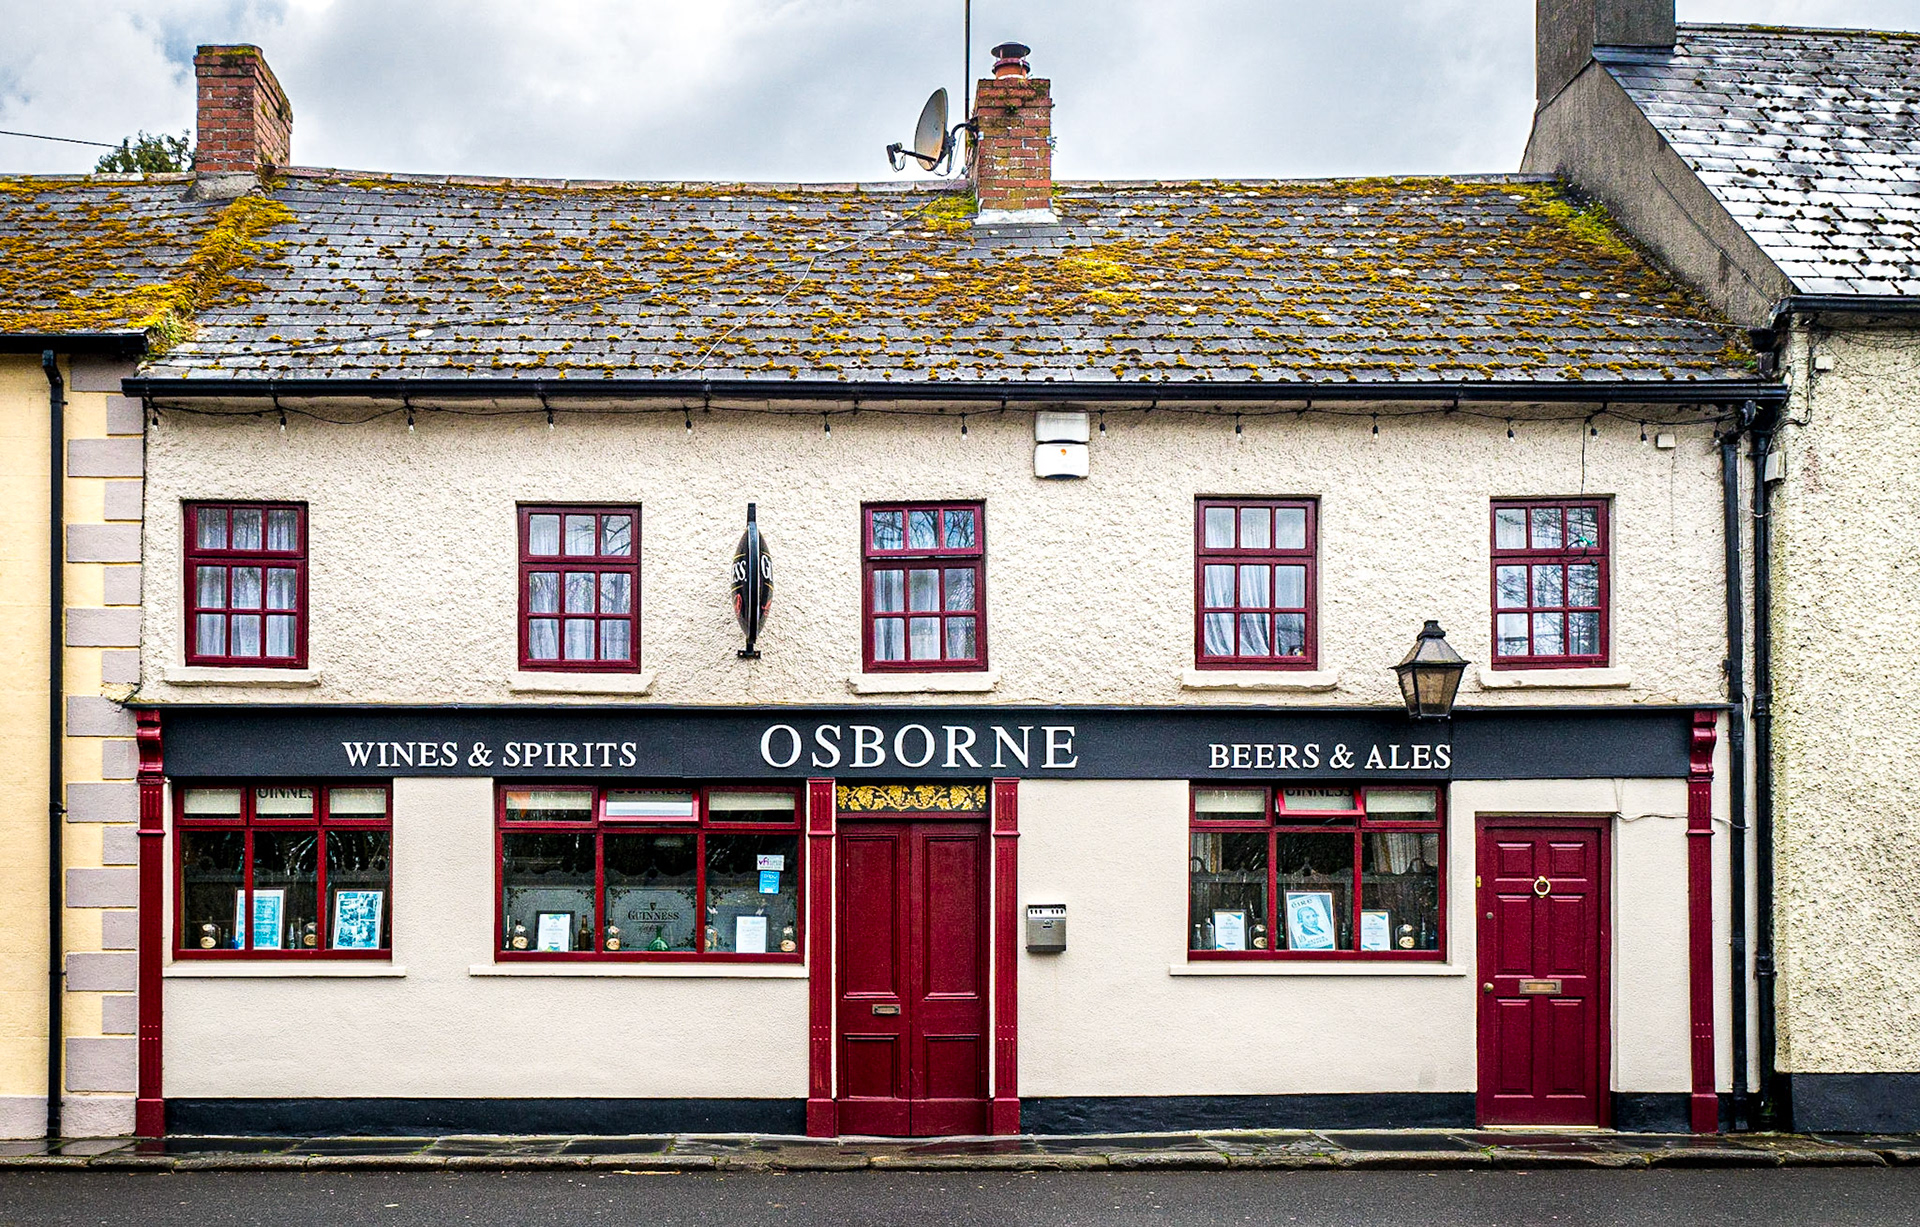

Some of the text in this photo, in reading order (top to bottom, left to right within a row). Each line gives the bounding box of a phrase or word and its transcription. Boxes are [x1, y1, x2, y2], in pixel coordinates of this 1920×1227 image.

[342, 742, 637, 767] WINES & SPIRITS
[761, 725, 1078, 769] OSBORNE
[1209, 744, 1451, 769] BEERS & ALES
[628, 910, 680, 920] GUINNESS
